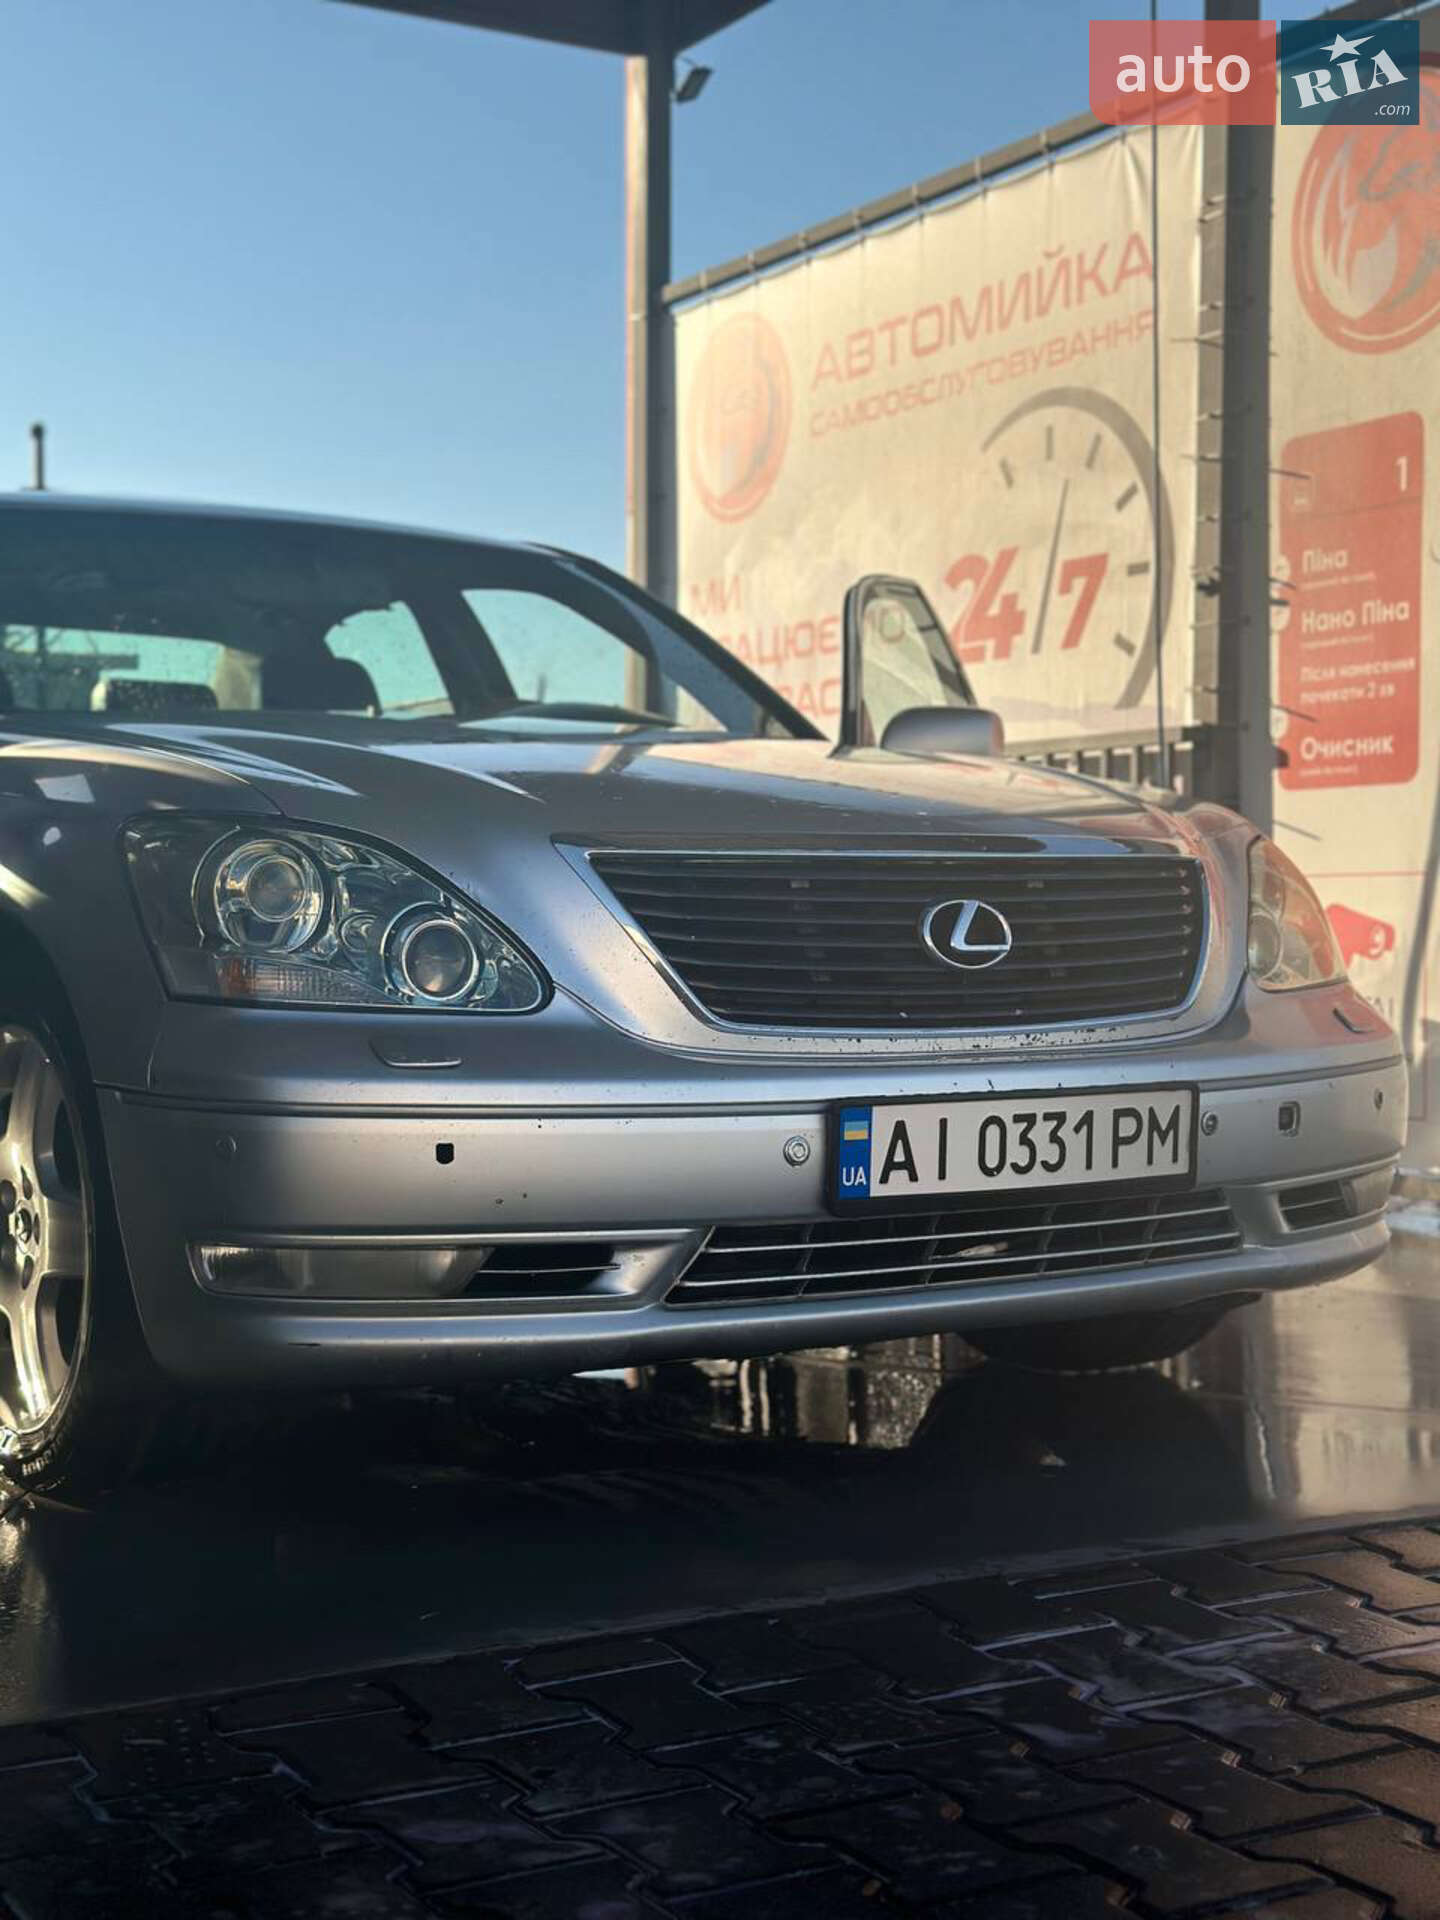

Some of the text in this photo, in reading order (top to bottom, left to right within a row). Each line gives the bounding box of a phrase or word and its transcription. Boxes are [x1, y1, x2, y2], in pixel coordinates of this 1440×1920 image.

[810, 232, 1153, 393] АВТОМИЙКА
[1395, 456, 1408, 491] 1
[1302, 548, 1349, 574] Піна
[1301, 598, 1410, 633] Нано Піна
[1301, 736, 1394, 761] Очисник
[977, 1109, 1095, 1177] 0331
[1111, 1104, 1181, 1169] PM
[842, 1166, 867, 1187] UA
